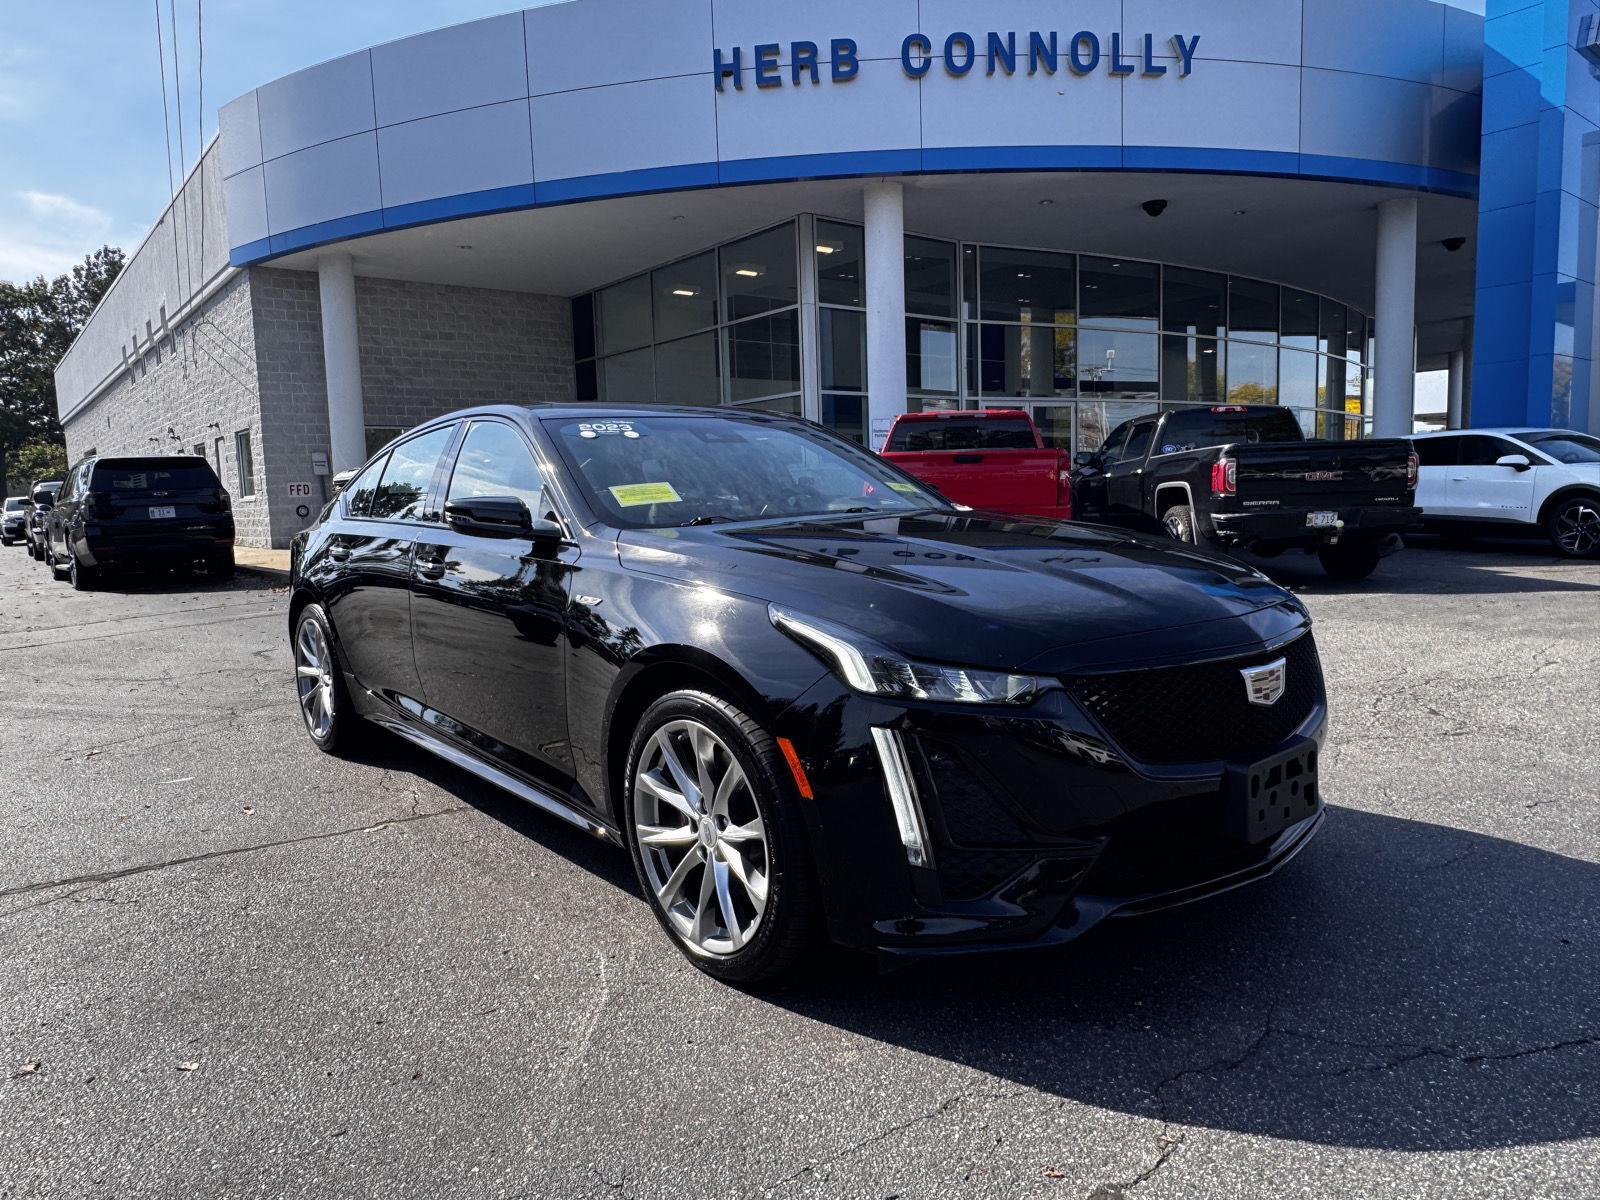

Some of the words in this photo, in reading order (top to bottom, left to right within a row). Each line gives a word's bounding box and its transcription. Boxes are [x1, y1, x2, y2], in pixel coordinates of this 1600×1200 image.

[713, 38, 860, 91] HERB
[900, 30, 1201, 80] CONNOLLY
[578, 423, 633, 431] 2023
[1305, 471, 1343, 481] GMC
[289, 484, 310, 496] FFD
